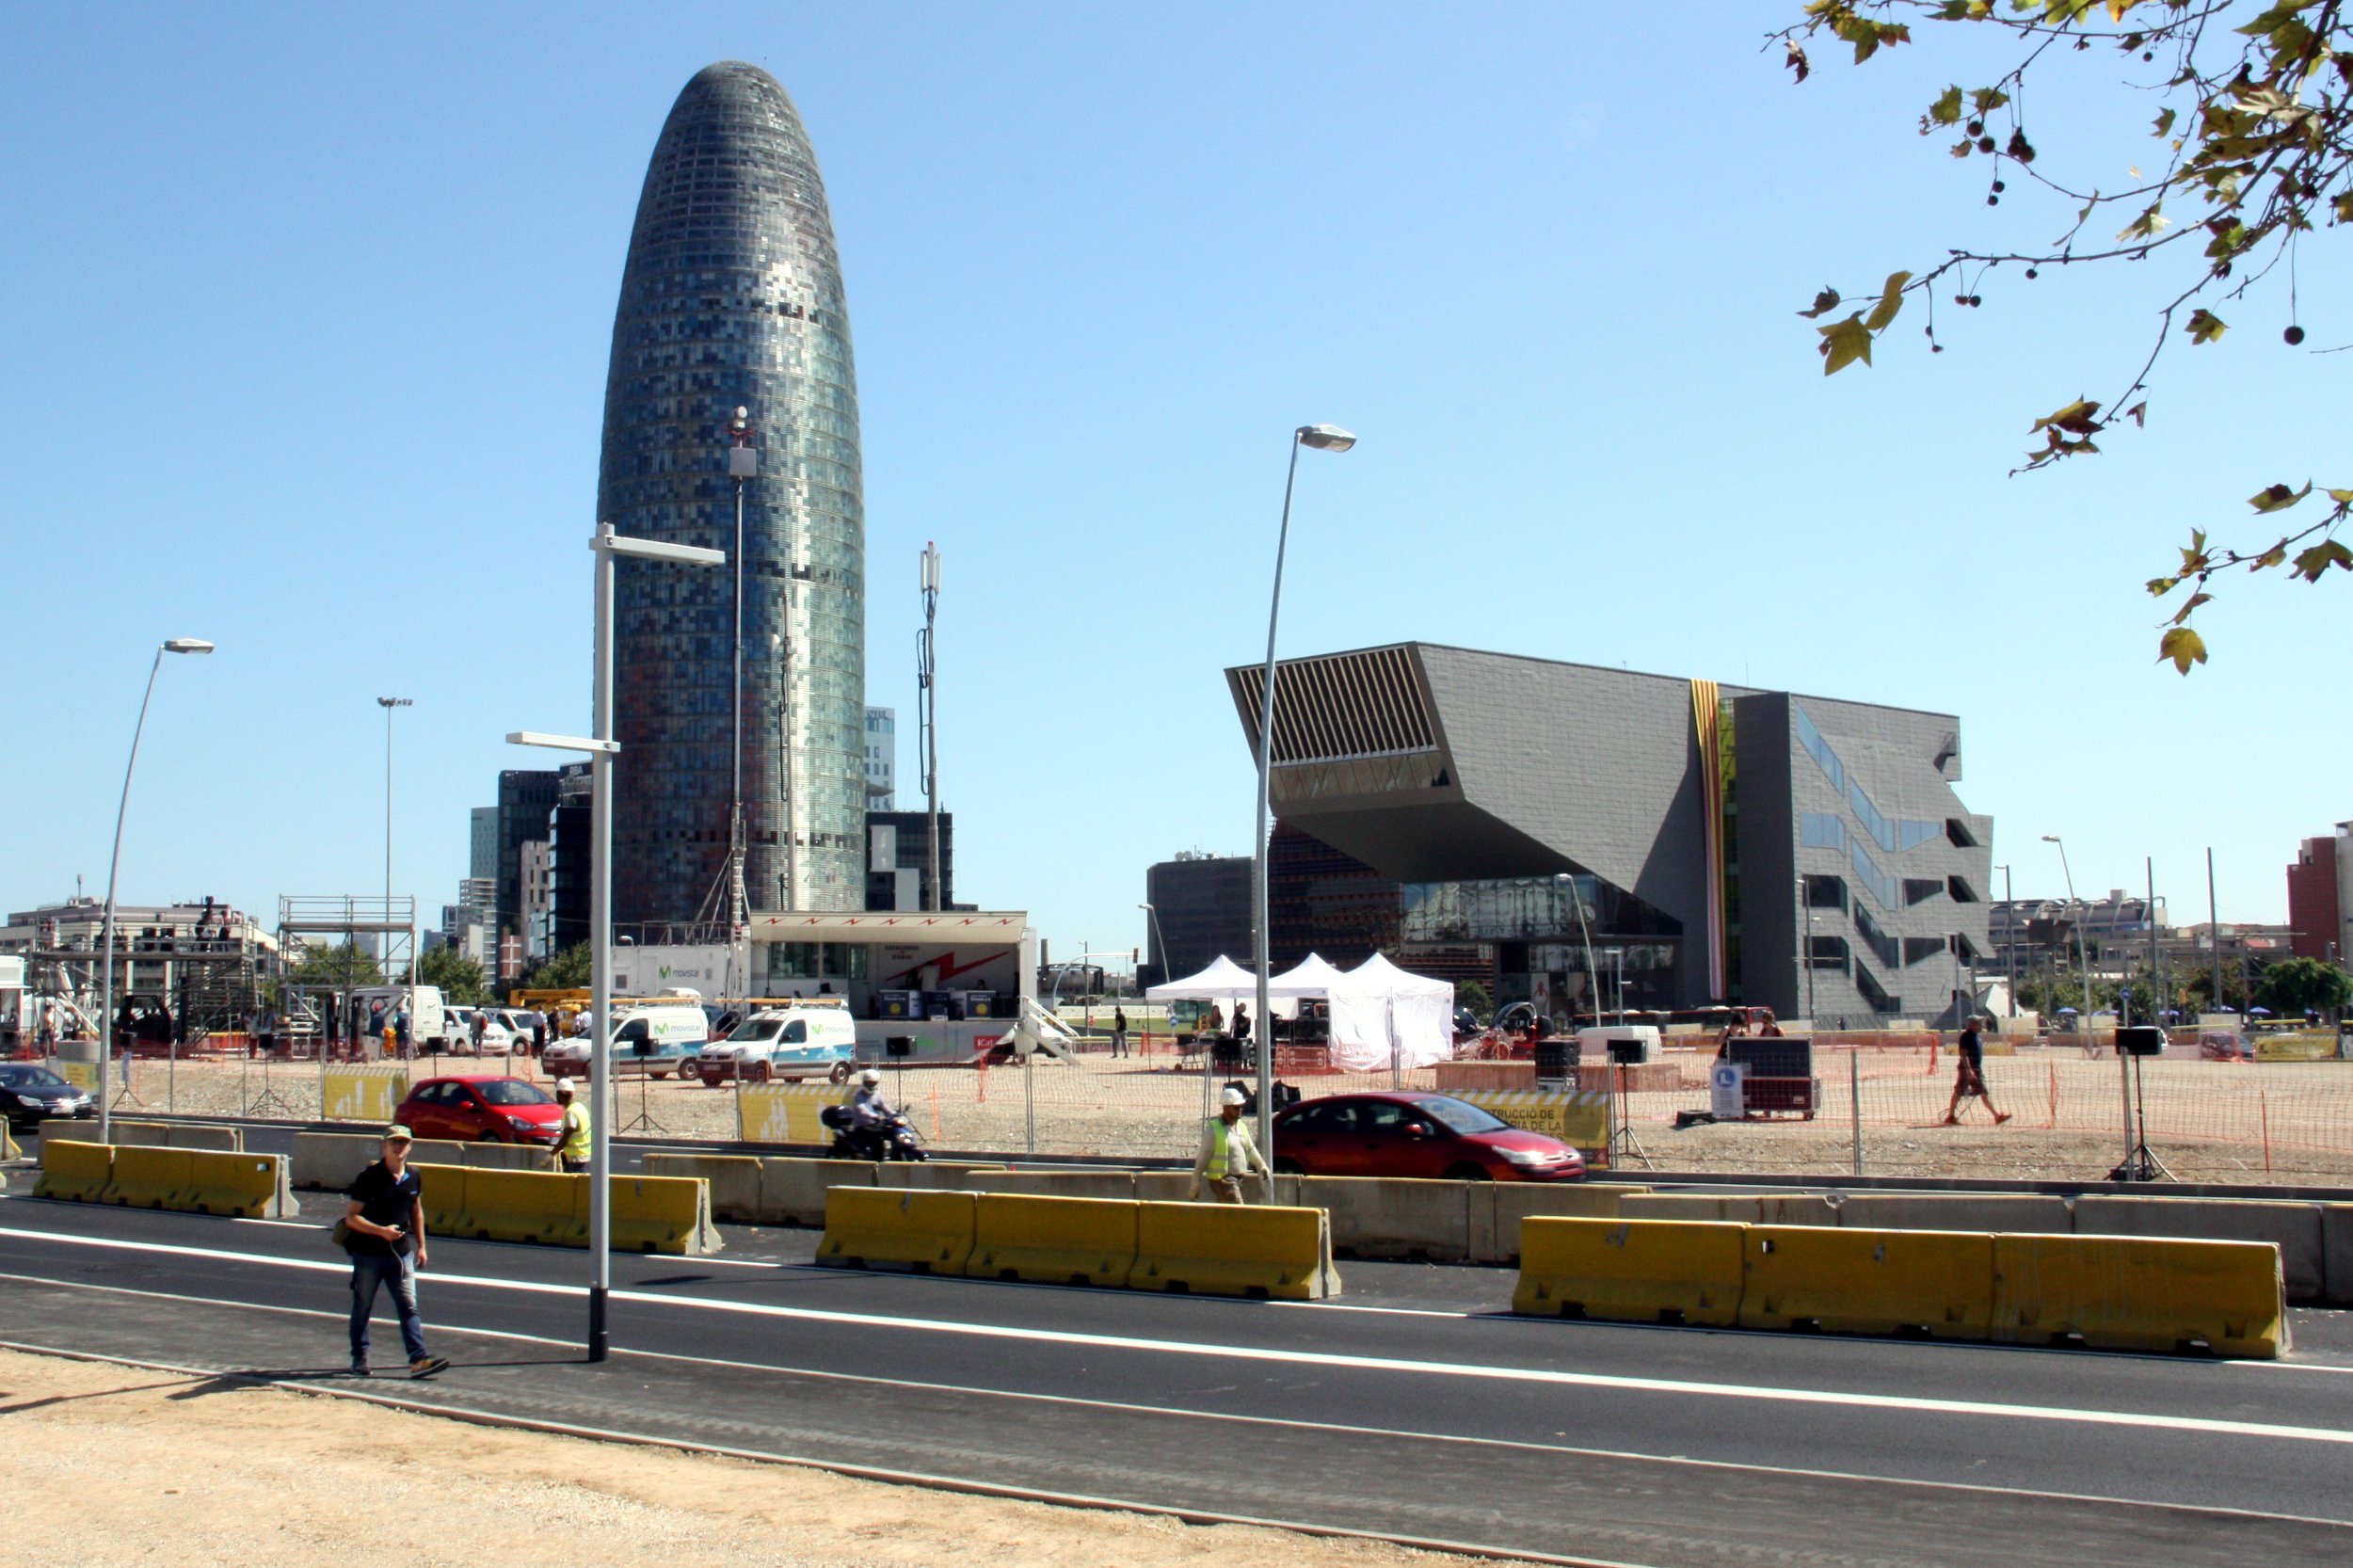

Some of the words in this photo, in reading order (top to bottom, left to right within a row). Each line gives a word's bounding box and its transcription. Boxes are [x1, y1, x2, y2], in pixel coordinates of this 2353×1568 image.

[672, 969, 699, 978] movistar
[670, 1024, 701, 1033] movistar
[1540, 1110, 1555, 1119] DE
[1530, 1121, 1545, 1130] DE
[1548, 1121, 1562, 1130] LA
